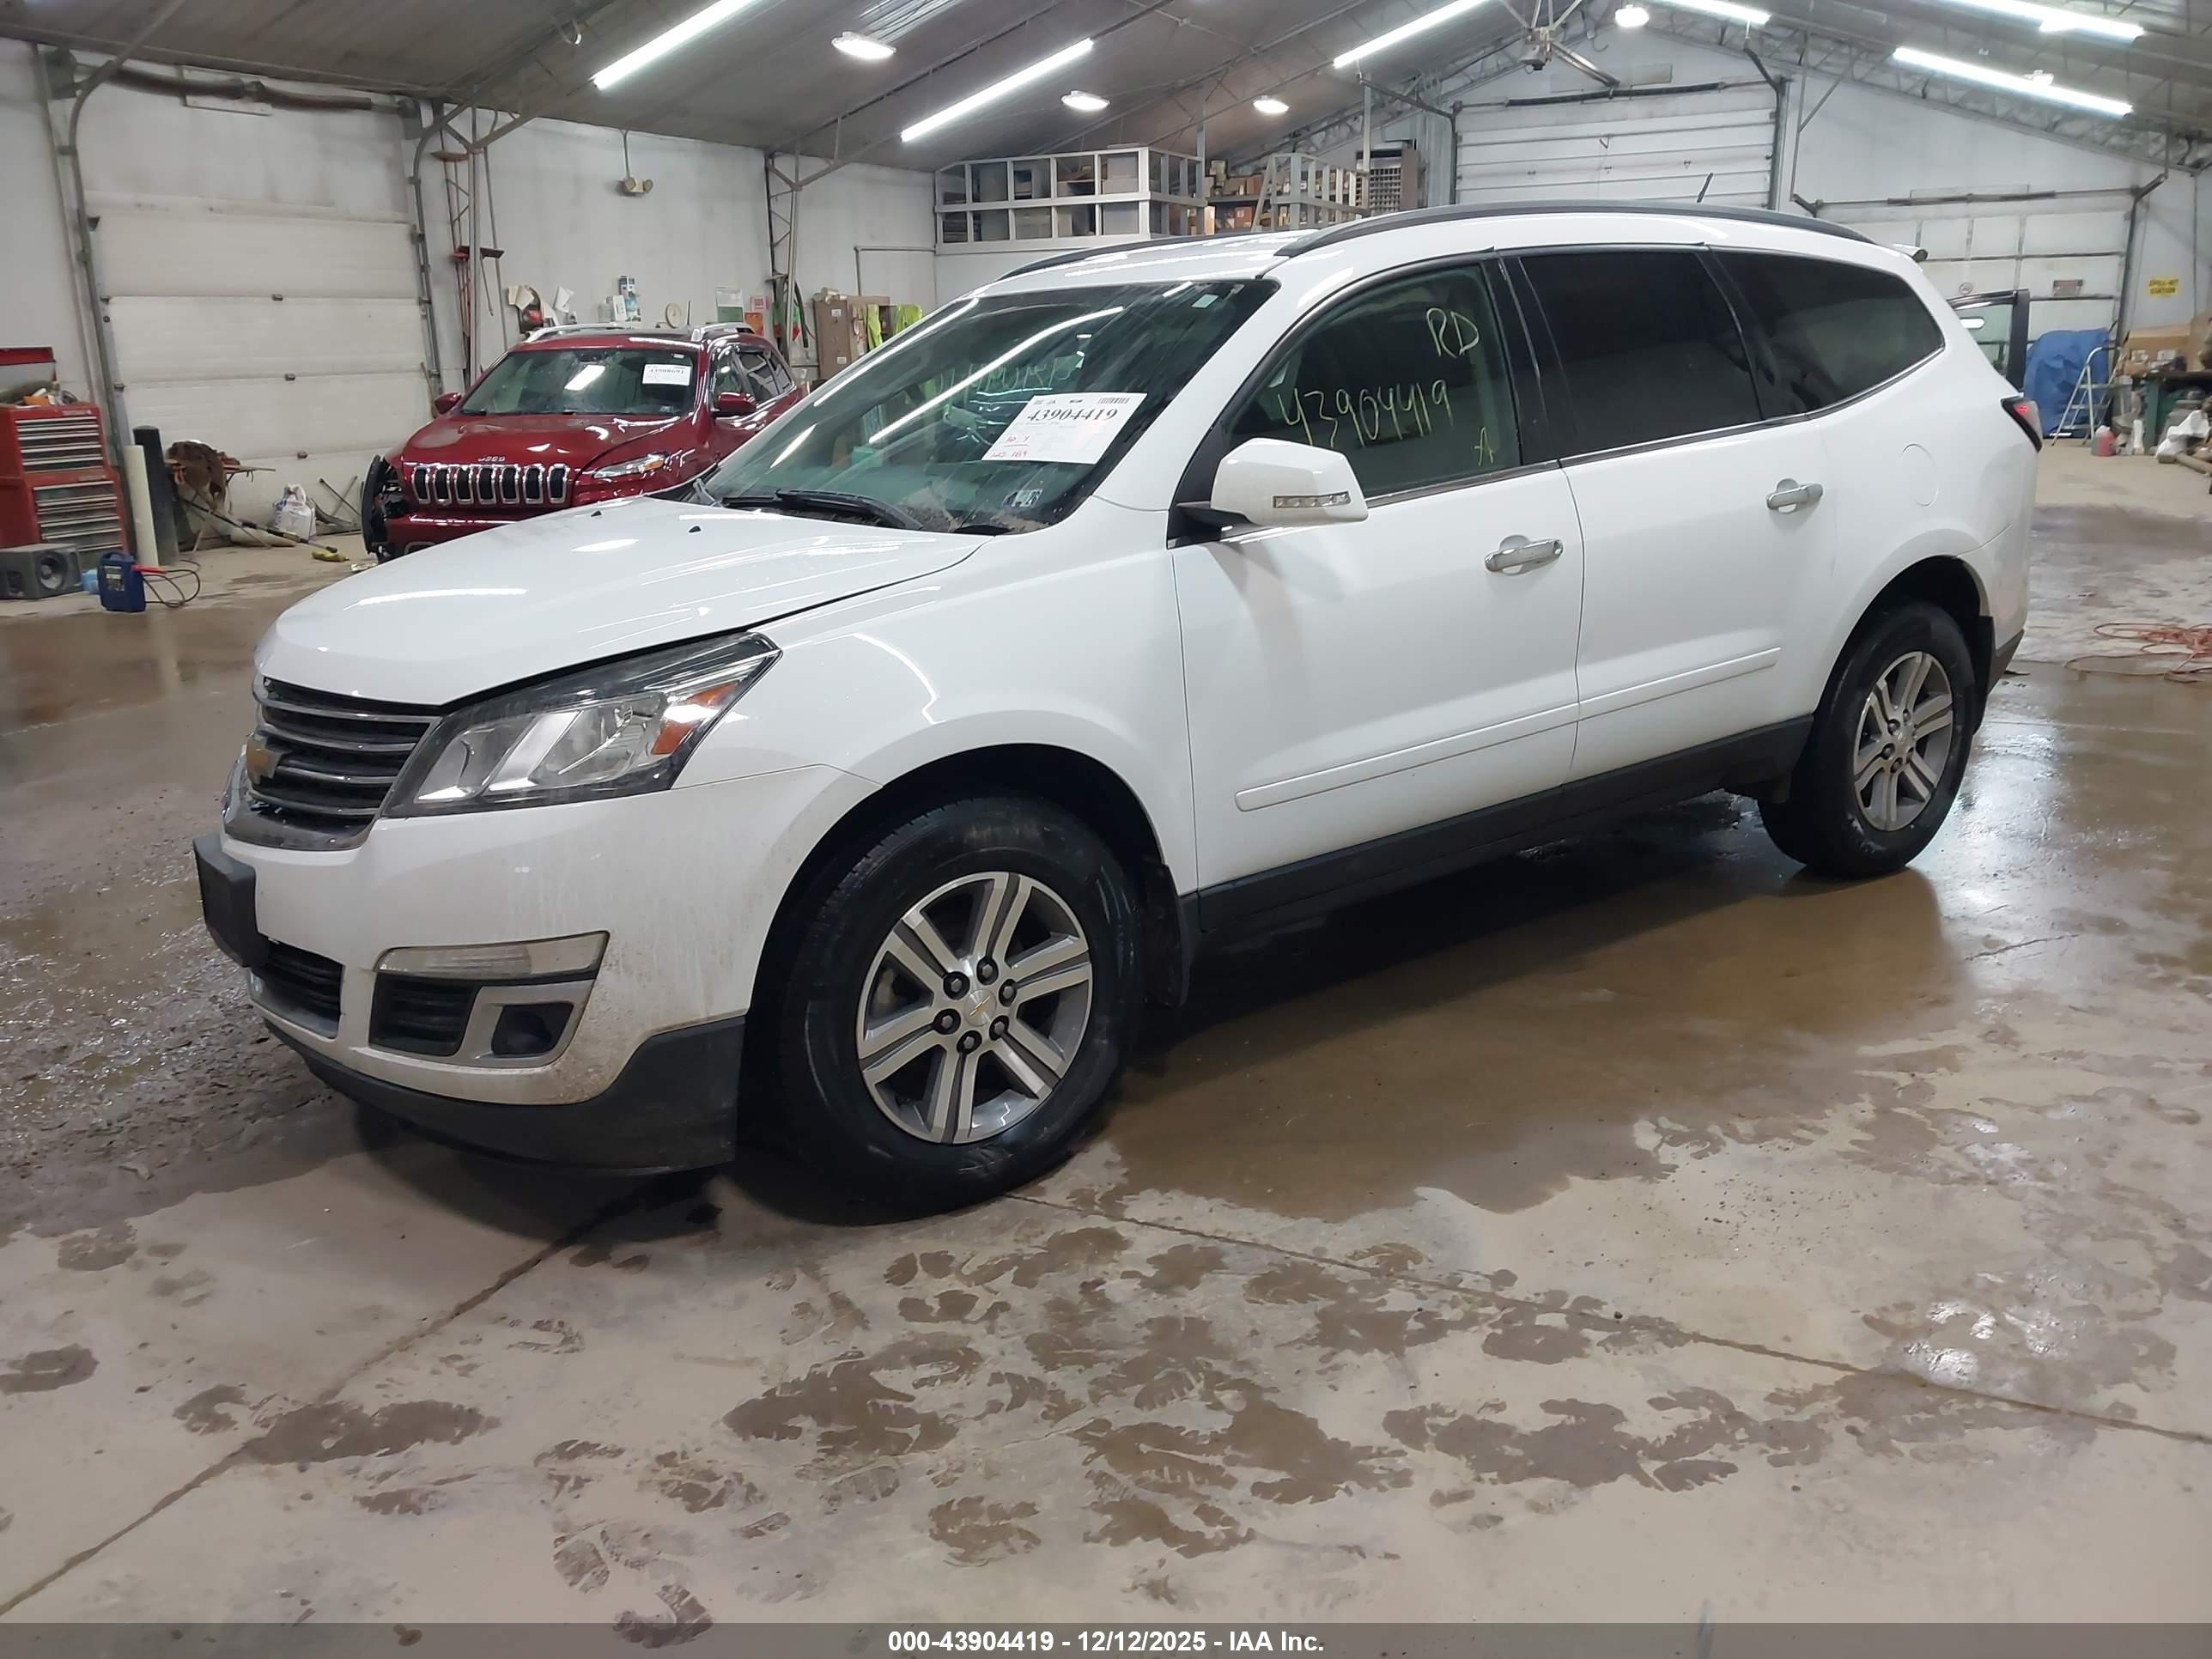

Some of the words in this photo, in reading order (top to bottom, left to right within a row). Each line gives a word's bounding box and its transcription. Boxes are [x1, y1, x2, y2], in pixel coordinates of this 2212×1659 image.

[1425, 307, 1480, 359] RD
[1027, 408, 1119, 422] 43904419
[1277, 378, 1455, 449] 43904419
